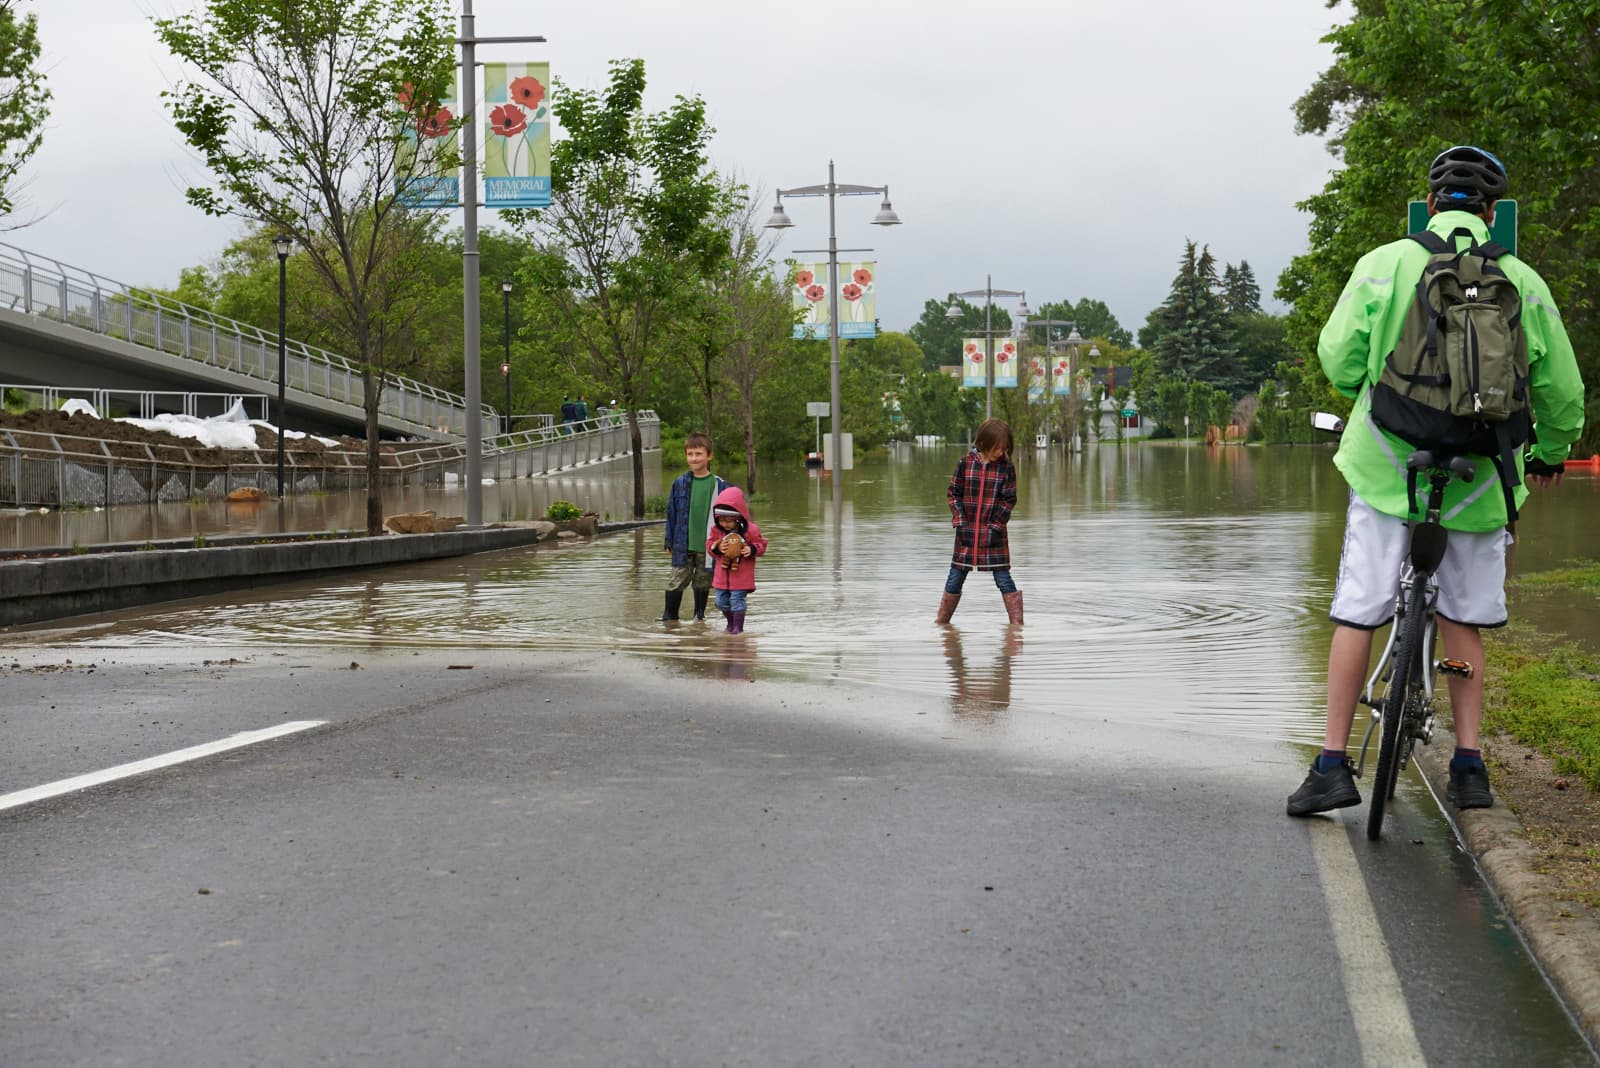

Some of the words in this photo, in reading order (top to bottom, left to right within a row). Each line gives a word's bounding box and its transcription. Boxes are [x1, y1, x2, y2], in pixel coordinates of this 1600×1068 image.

[399, 180, 454, 192] MORIAL
[489, 179, 545, 191] MEMORIAL
[489, 191, 520, 200] DRIVE
